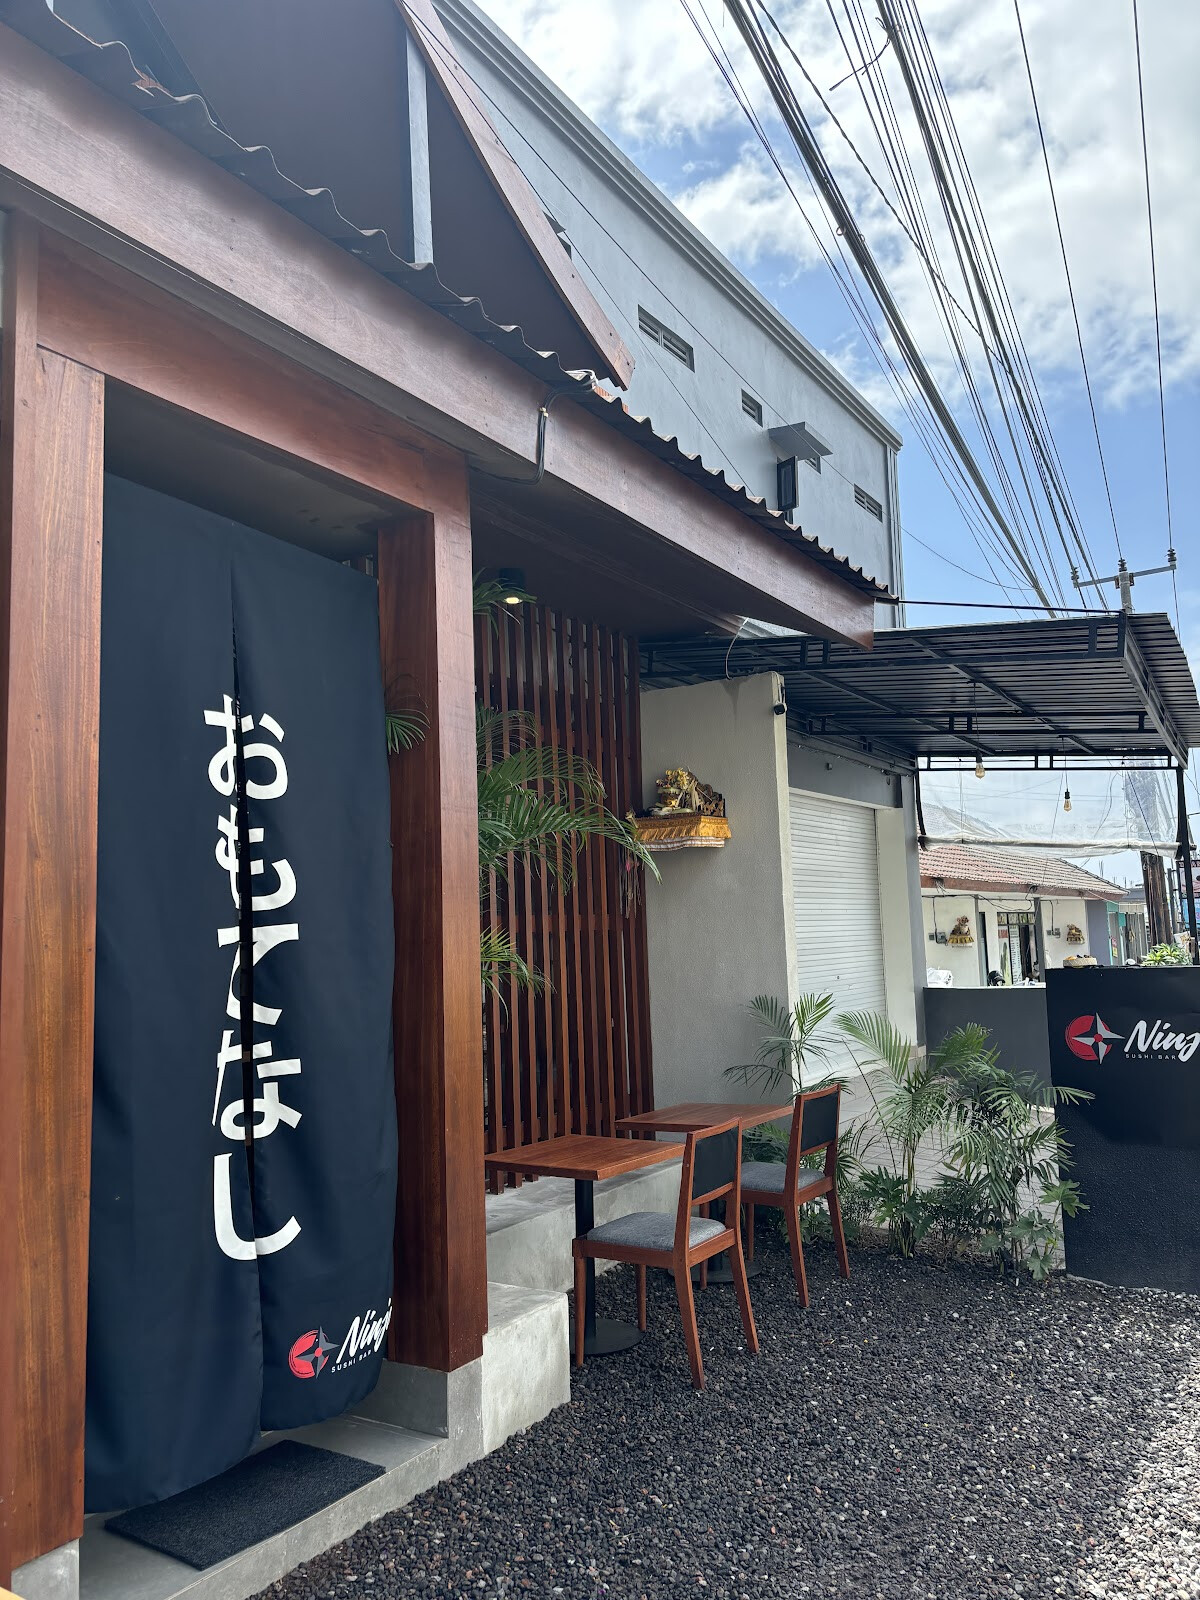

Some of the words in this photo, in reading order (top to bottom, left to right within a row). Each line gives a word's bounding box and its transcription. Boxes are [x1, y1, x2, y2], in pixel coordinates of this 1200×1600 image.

[203, 693, 302, 1261] おもてなし
[331, 1358, 356, 1373] SUSHI
[358, 1349, 372, 1361] BAR
